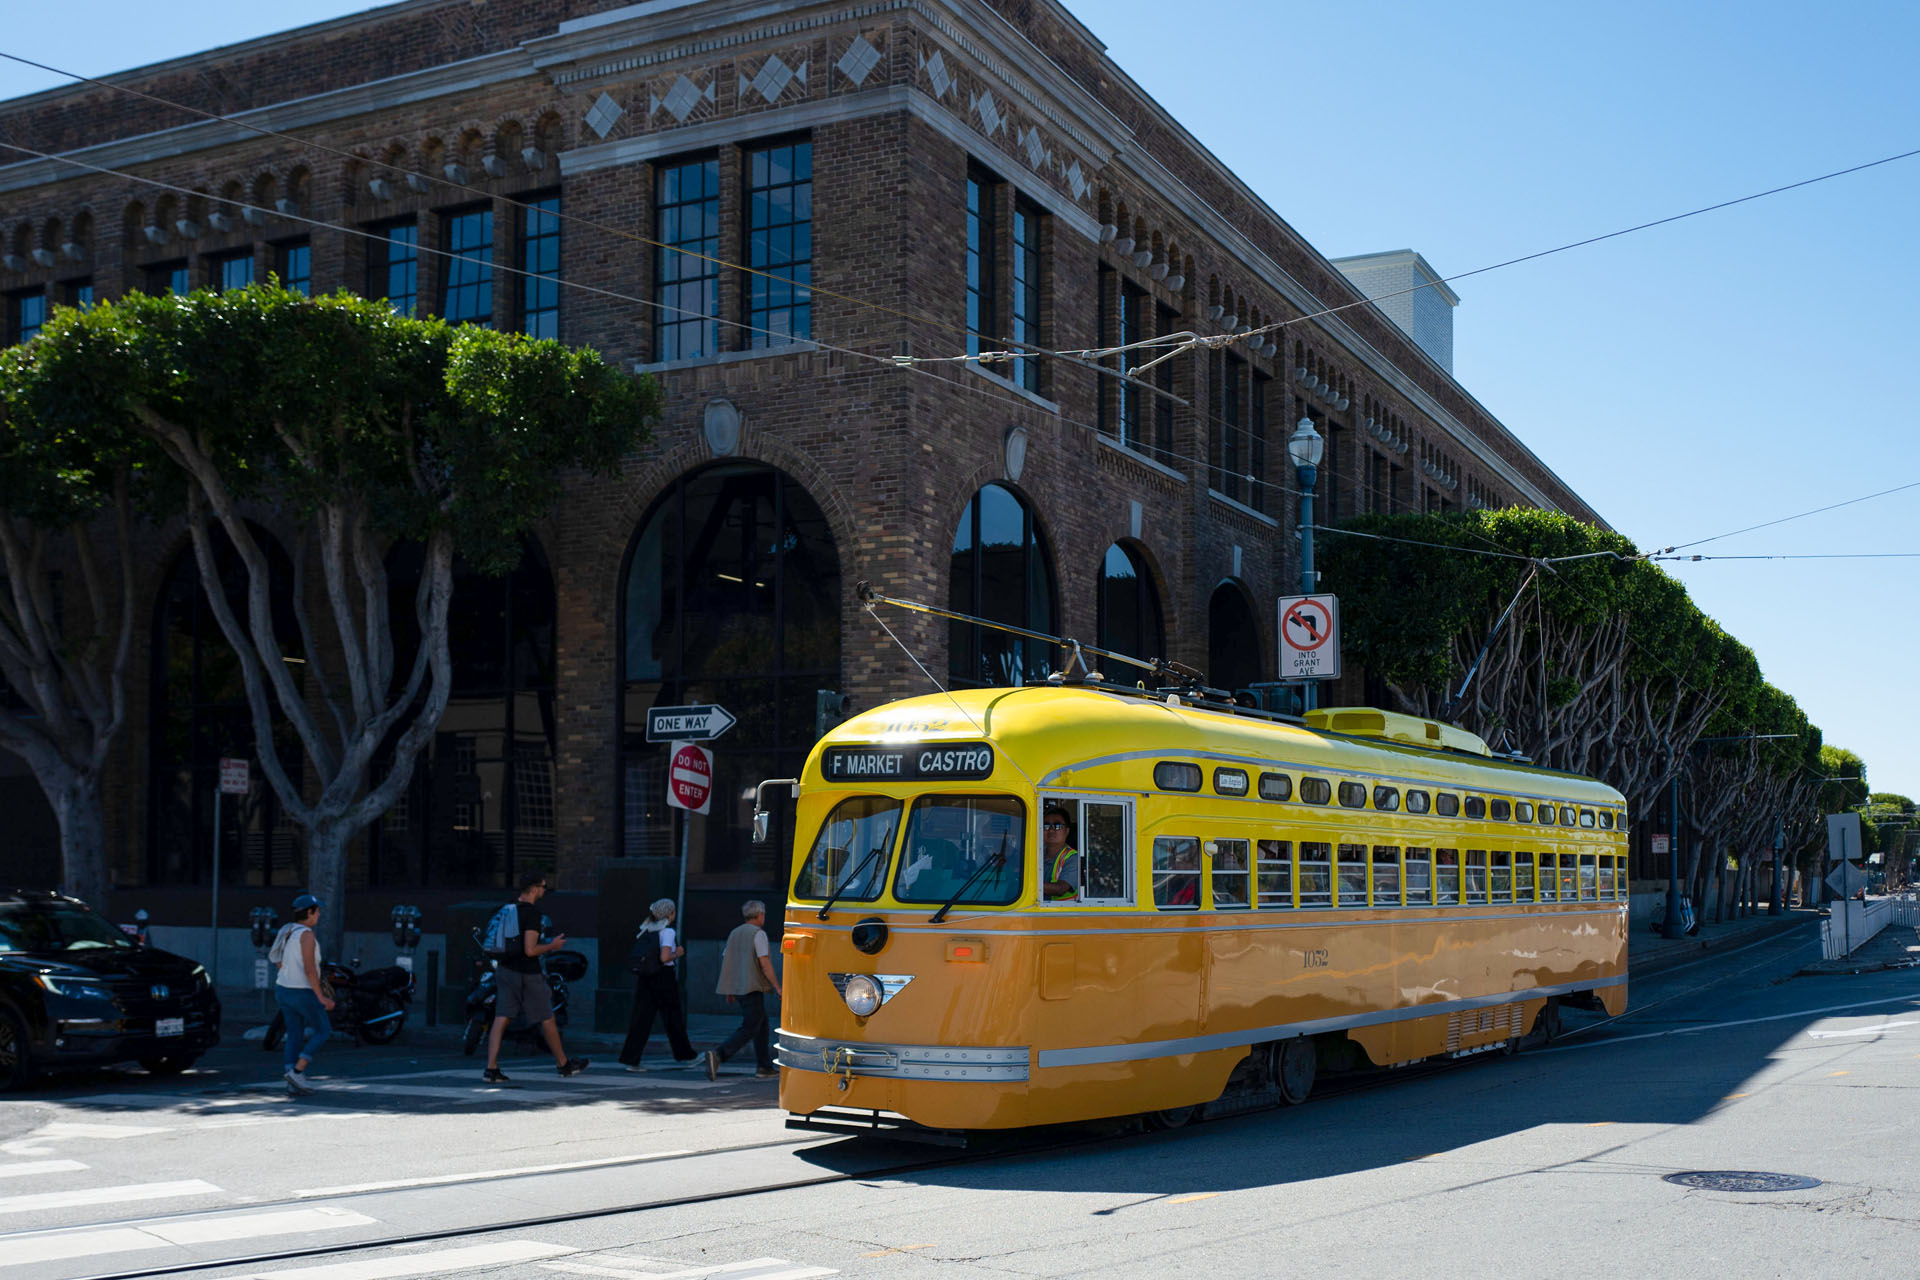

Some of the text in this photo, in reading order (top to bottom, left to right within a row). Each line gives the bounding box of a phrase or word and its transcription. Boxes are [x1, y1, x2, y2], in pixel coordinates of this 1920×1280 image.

[1298, 651, 1317, 659] INTO
[1293, 659, 1321, 667] GRANT
[657, 716, 709, 730] ONE WAY
[678, 755, 707, 771] DO NOT
[833, 750, 991, 774] F MARKET CASTRO
[679, 784, 703, 799] ENTER
[1304, 949, 1328, 968] 1052
